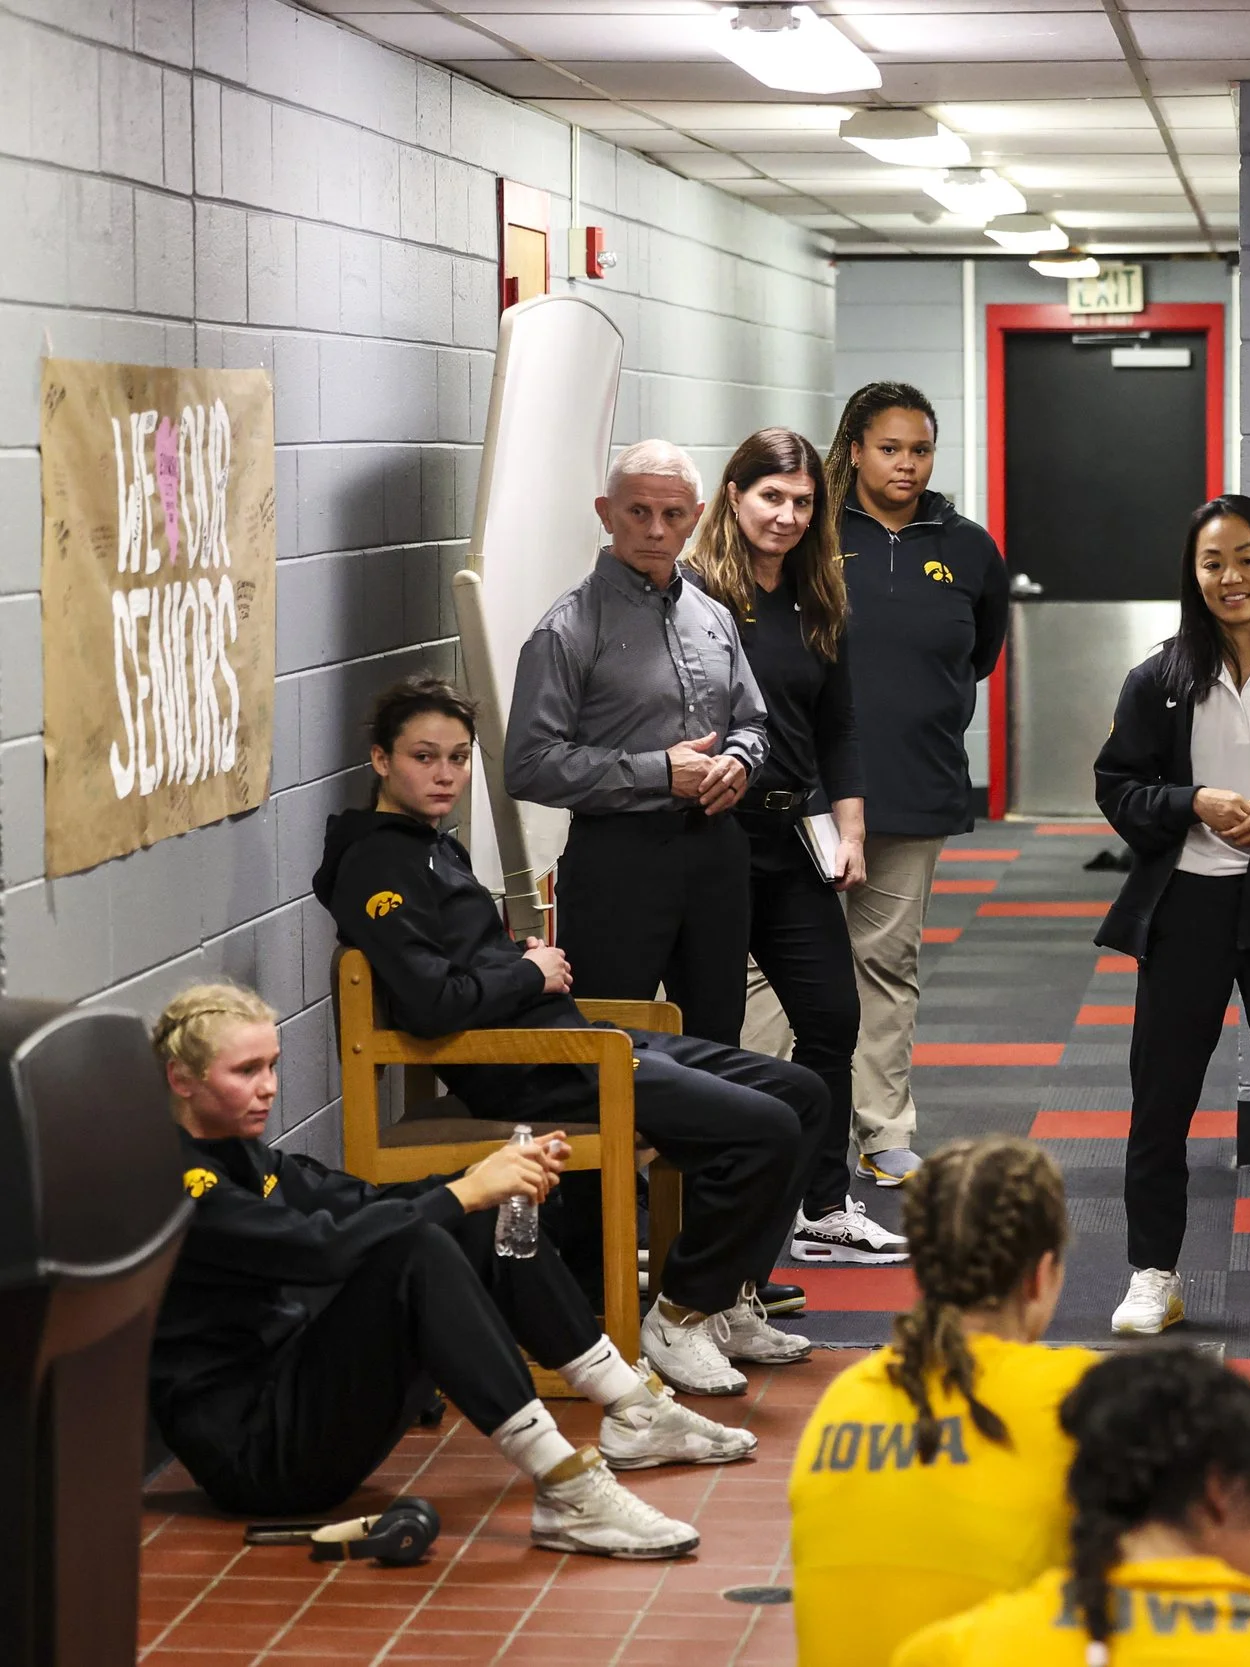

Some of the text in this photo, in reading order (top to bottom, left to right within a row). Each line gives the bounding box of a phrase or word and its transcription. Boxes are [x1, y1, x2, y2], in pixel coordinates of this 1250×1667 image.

[112, 409, 161, 575] WE
[179, 397, 232, 569] OUR
[110, 574, 240, 800] SENIORS
[811, 1416, 970, 1473] IOWA
